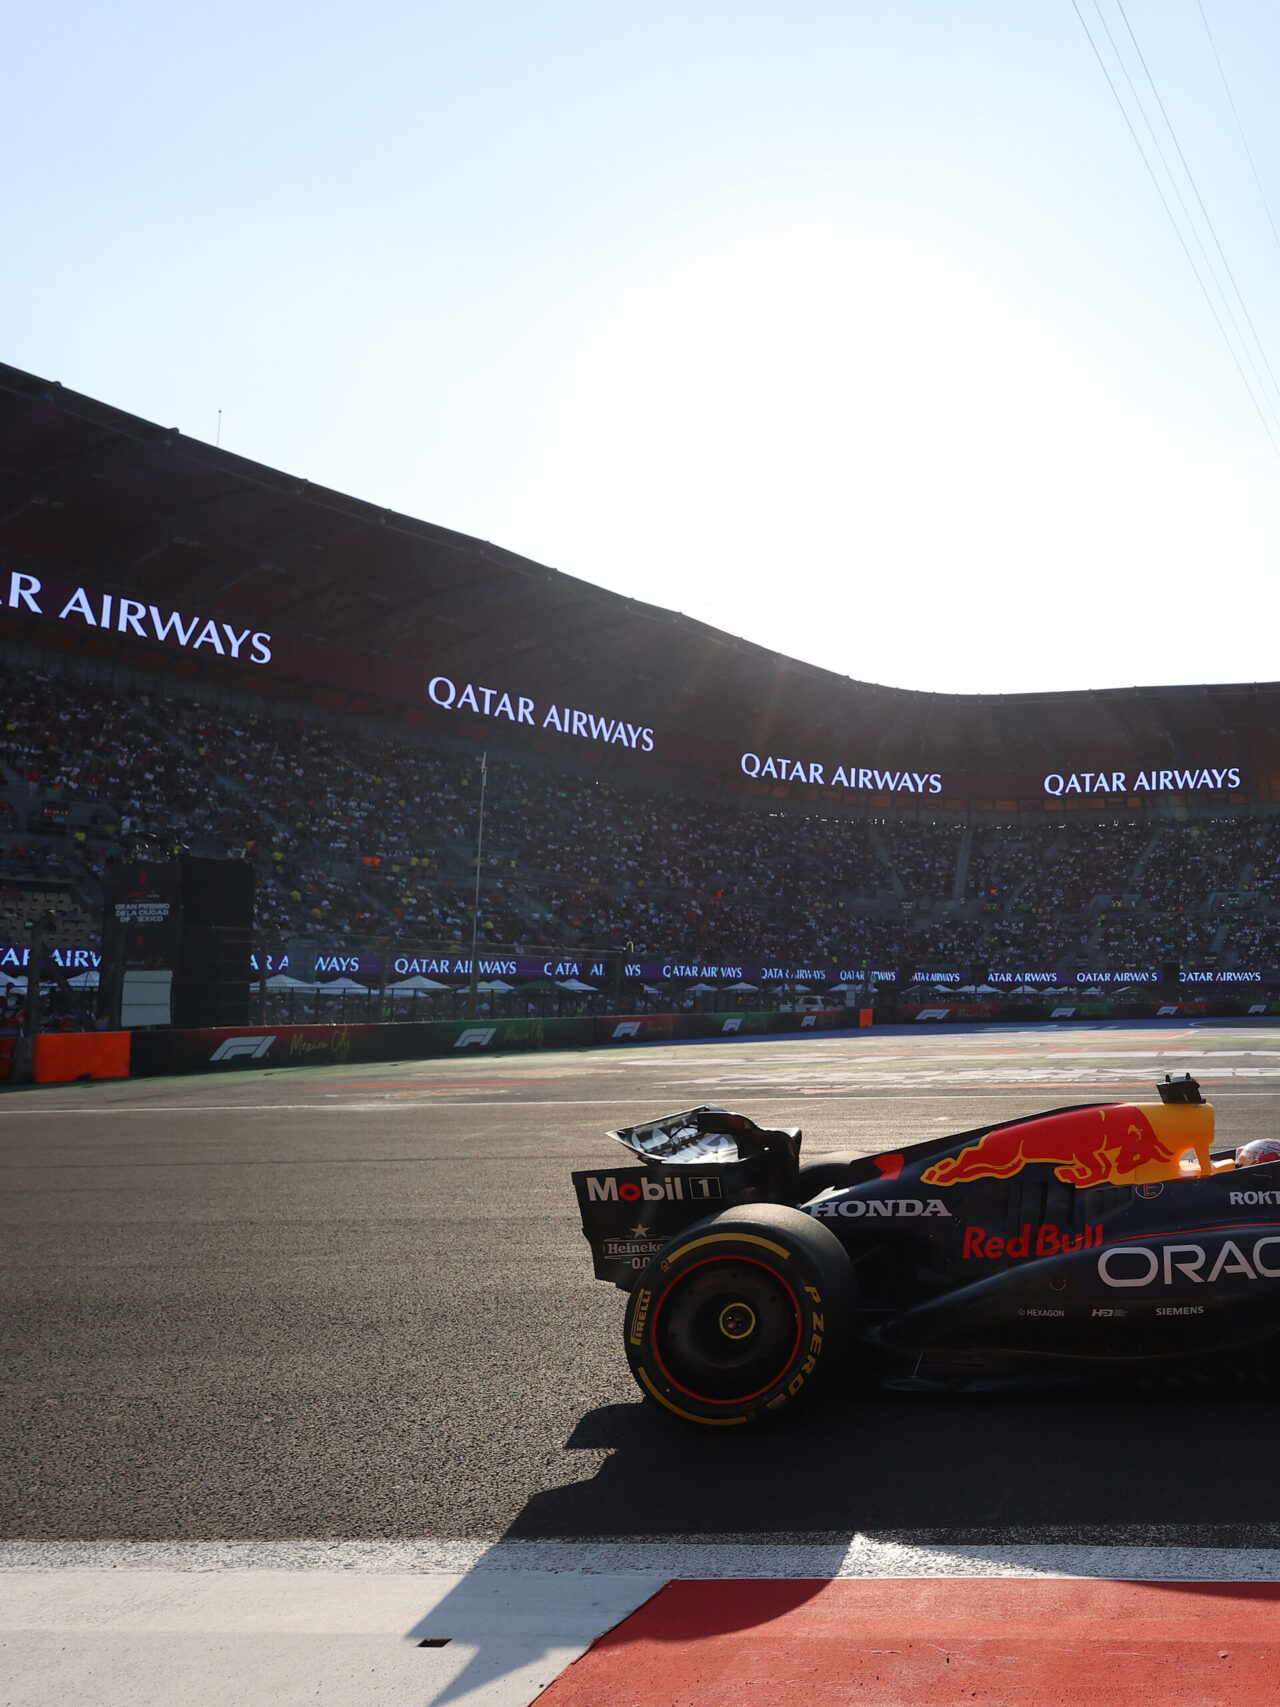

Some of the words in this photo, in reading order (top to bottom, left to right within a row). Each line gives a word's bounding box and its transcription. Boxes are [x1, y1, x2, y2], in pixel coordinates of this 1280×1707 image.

[59, 587, 272, 665] AIRWAYS
[428, 676, 536, 726] QATAR
[543, 704, 655, 752] AIRWAYS
[740, 752, 825, 784] QATAR
[831, 765, 943, 794] AIRWAYS
[1043, 772, 1127, 796] QATAR
[1133, 767, 1241, 792] AIRWAYS
[394, 958, 449, 975] QATAR
[1076, 972, 1110, 983] QATAR
[586, 1177, 684, 1202] Mobil
[809, 1199, 952, 1217] HONDA
[962, 1223, 1031, 1259] Red
[1036, 1223, 1103, 1257] Bull
[630, 1288, 652, 1346] PIRELLI
[1027, 1309, 1065, 1318] HEXAGON
[1155, 1305, 1205, 1316] SIEMENS
